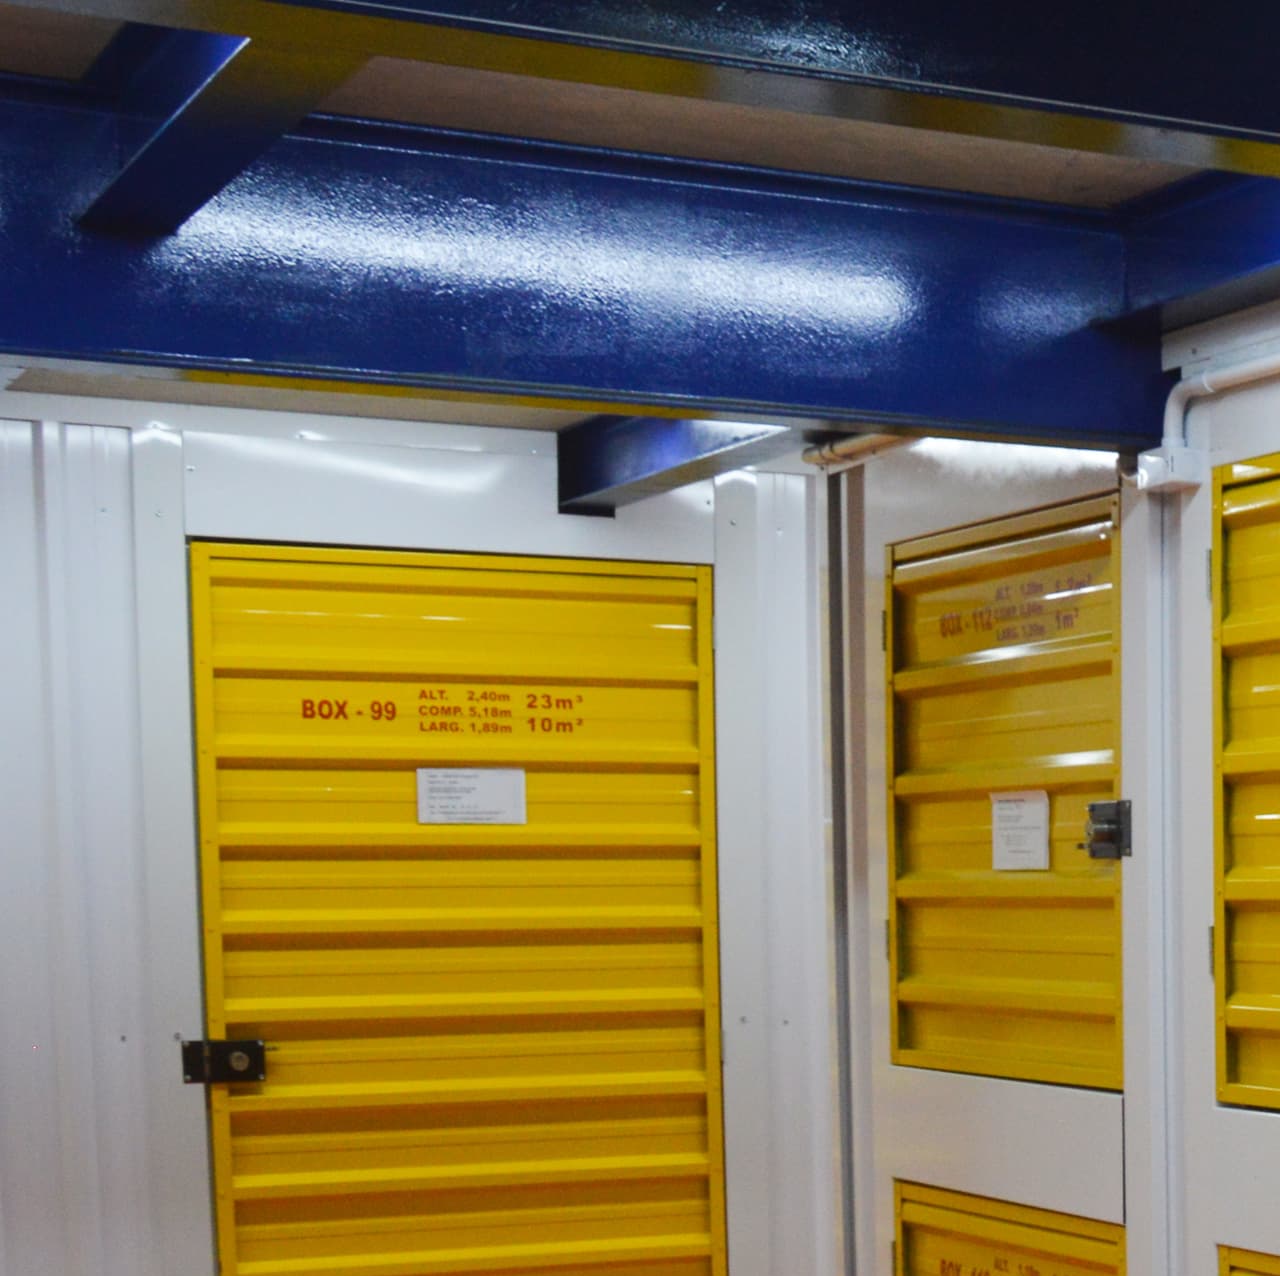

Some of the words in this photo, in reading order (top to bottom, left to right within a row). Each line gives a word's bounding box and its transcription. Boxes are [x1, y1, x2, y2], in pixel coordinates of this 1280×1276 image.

[419, 690, 448, 700] ALT.
[467, 690, 510, 702] 2,40m
[302, 699, 348, 720] BOX
[370, 701, 397, 721] 99
[419, 706, 463, 717] COMP.
[420, 722, 464, 733] LARG.
[470, 722, 512, 733] 1,89m
